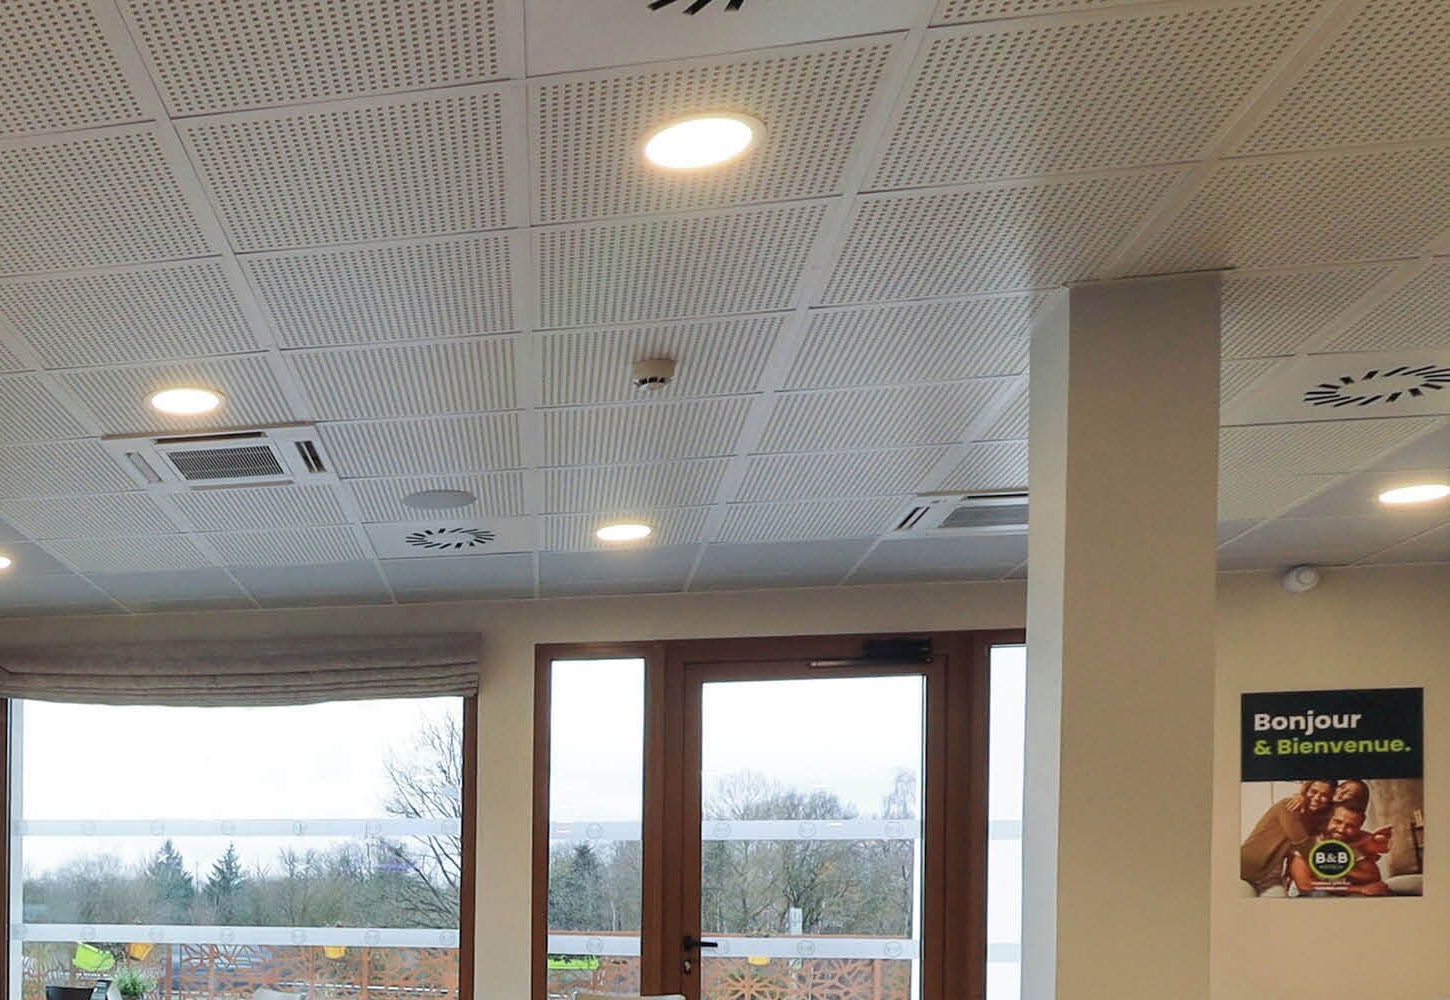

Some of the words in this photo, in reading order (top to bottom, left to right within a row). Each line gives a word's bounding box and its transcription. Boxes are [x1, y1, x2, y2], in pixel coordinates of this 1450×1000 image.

[1254, 710, 1362, 736] Bonjour
[1254, 740, 1271, 755] &
[1277, 737, 1411, 755] Bienvenue.
[1315, 852, 1348, 864] B&B
